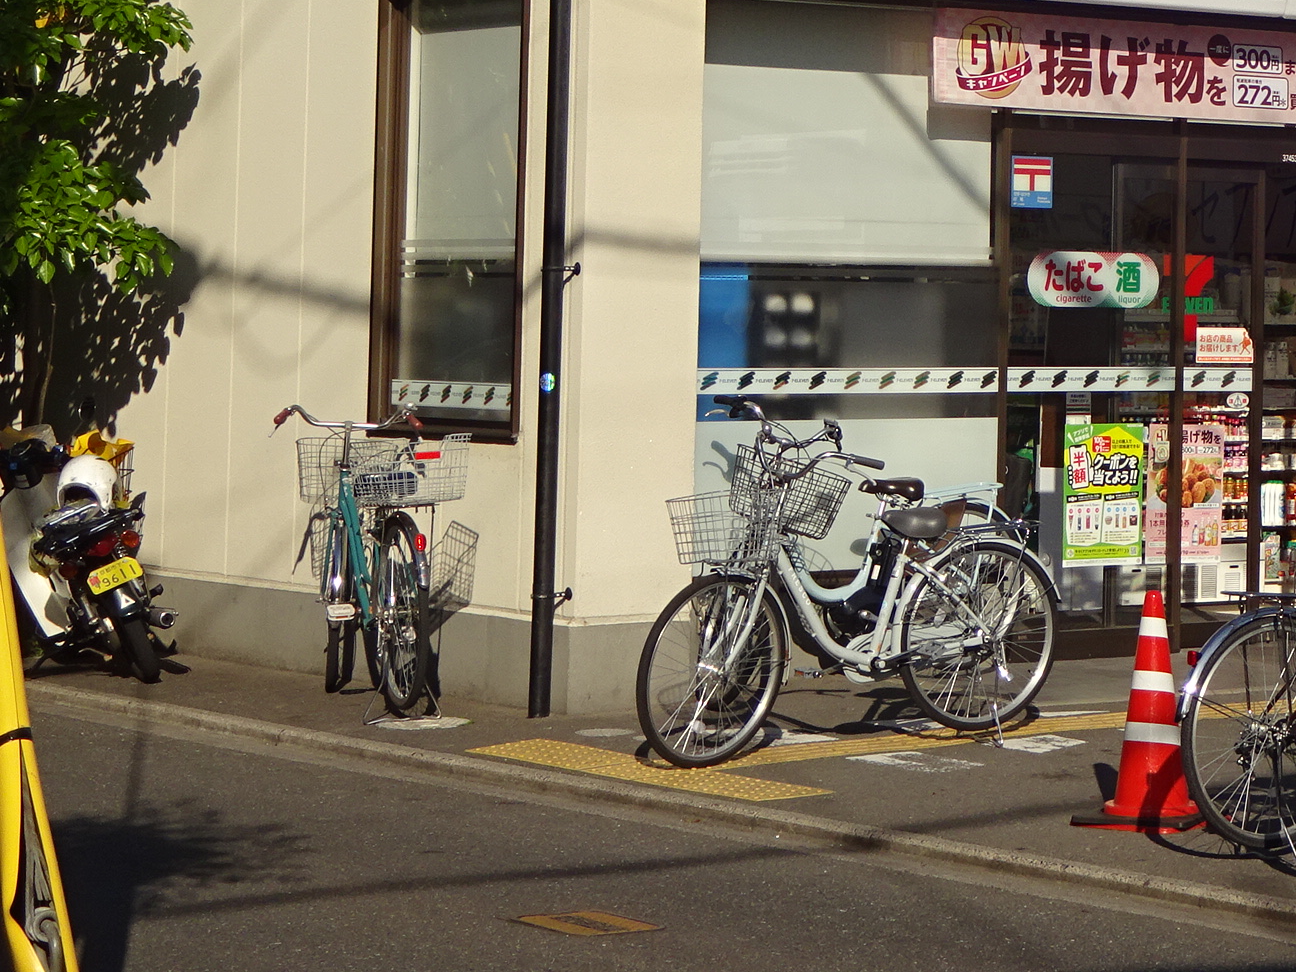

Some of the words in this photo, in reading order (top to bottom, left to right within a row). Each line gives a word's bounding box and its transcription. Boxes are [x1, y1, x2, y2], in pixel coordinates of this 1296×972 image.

[961, 24, 1021, 75] GW
[965, 64, 1027, 90] キャンペーン
[1044, 259, 1104, 293] たばこ
[1116, 261, 1141, 293] 酒
[1056, 293, 1092, 304] cigarette
[1118, 295, 1142, 304] liquor
[1199, 334, 1233, 343] お店の商品
[1073, 452, 1087, 485] 半額
[1093, 454, 1138, 470] クーポンを
[102, 564, 136, 587] 9611
